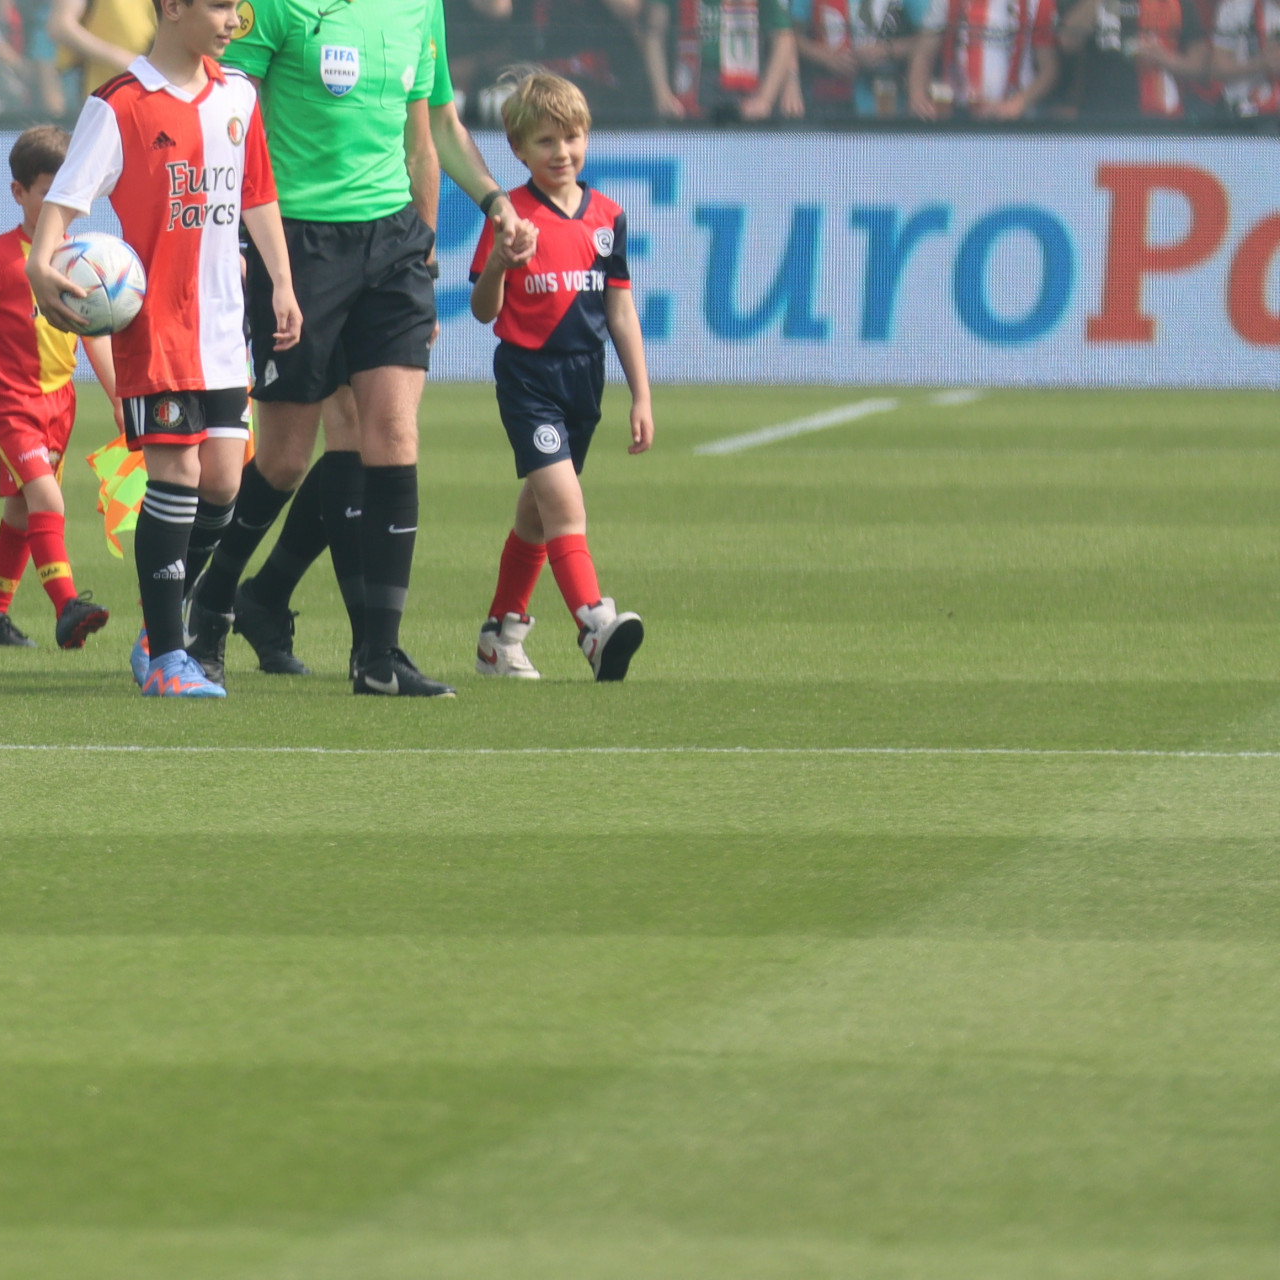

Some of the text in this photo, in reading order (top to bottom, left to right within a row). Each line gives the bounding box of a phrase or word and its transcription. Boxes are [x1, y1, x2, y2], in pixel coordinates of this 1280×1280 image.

[325, 49, 355, 62] FIFA
[165, 160, 237, 198] Euro
[166, 199, 236, 232] Parcs
[524, 271, 559, 295] ONS
